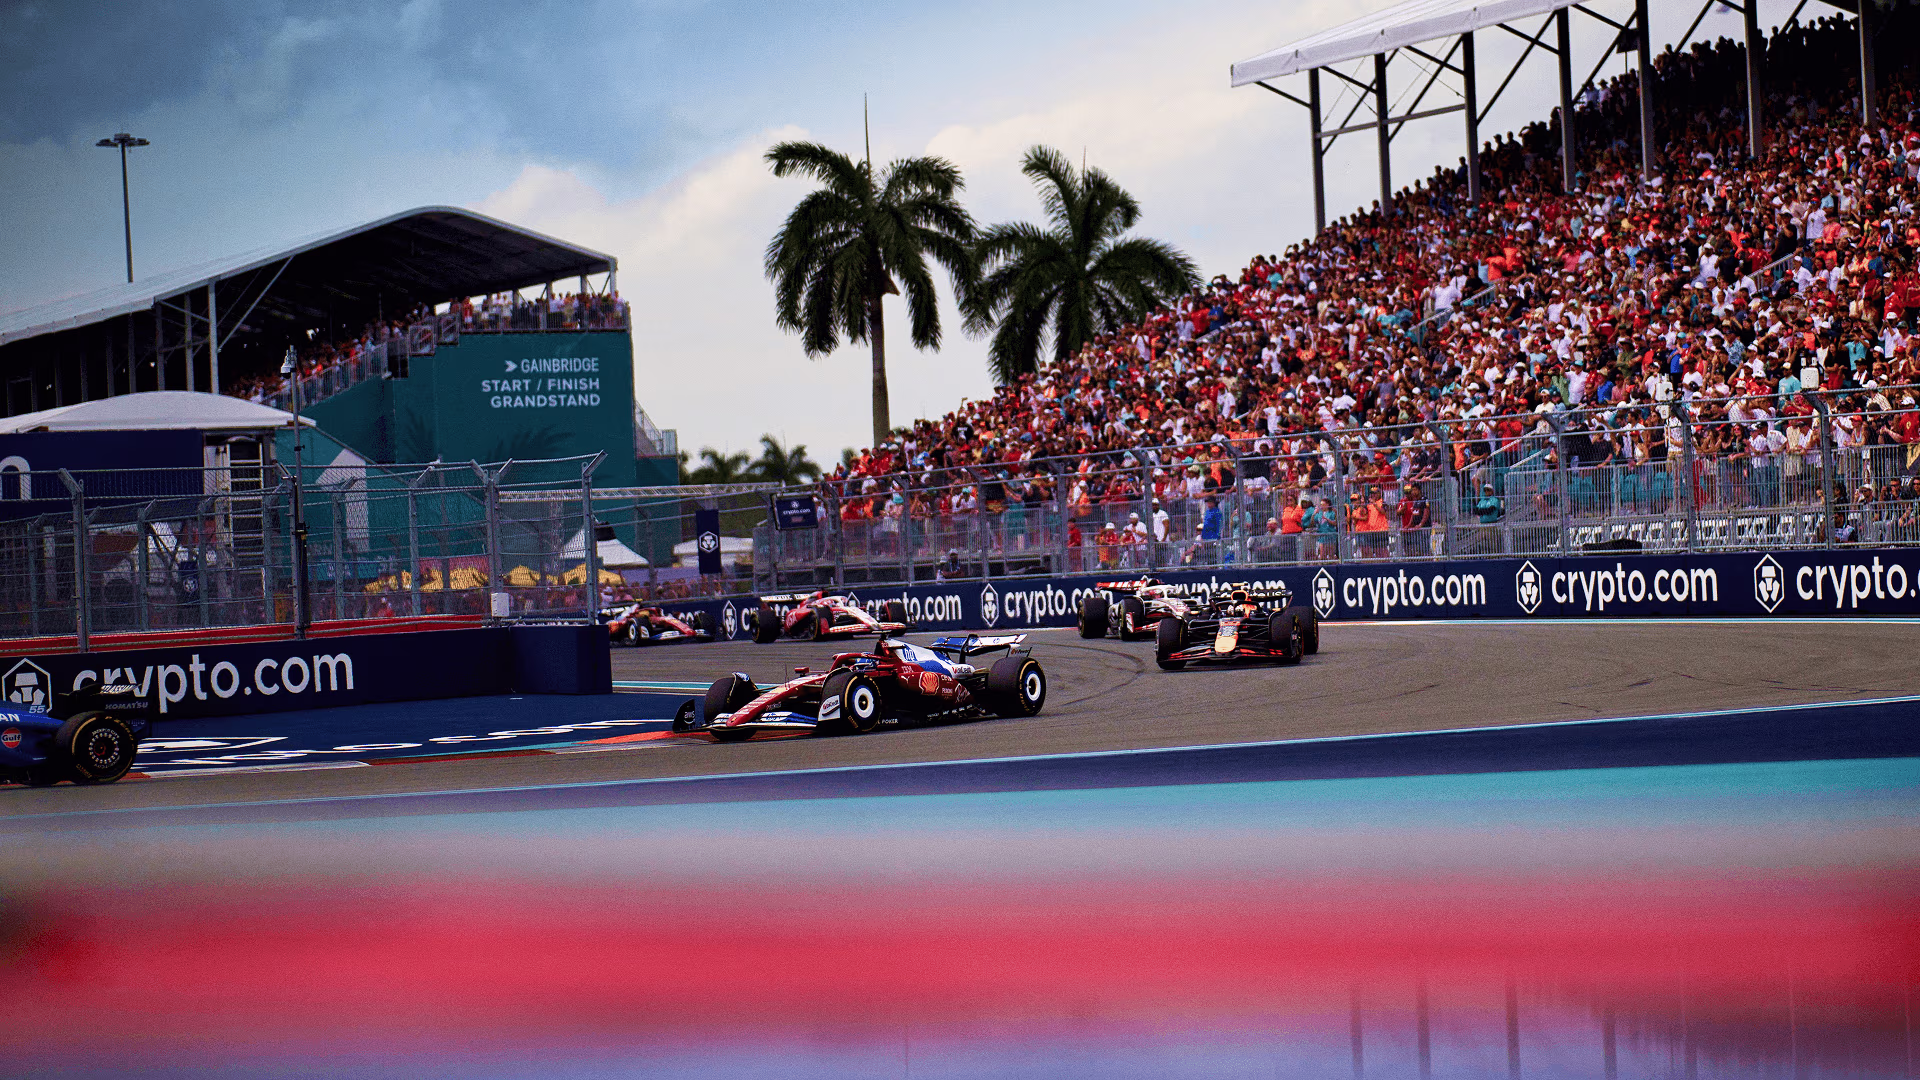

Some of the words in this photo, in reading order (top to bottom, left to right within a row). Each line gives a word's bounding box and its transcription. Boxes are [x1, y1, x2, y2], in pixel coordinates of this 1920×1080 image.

[521, 358, 600, 373] GAINBRIDGE
[481, 379, 531, 392] START
[536, 379, 542, 391] /
[547, 378, 600, 391] FINISH
[490, 394, 601, 408] GRANDSTAND
[1552, 562, 1718, 611] crypto.com
[1796, 556, 1920, 609] crypto.
[1343, 569, 1486, 614] crypto.com
[28, 705, 46, 714] 55
[105, 702, 149, 711] KOMATSU
[1, 733, 21, 742] Gulf
